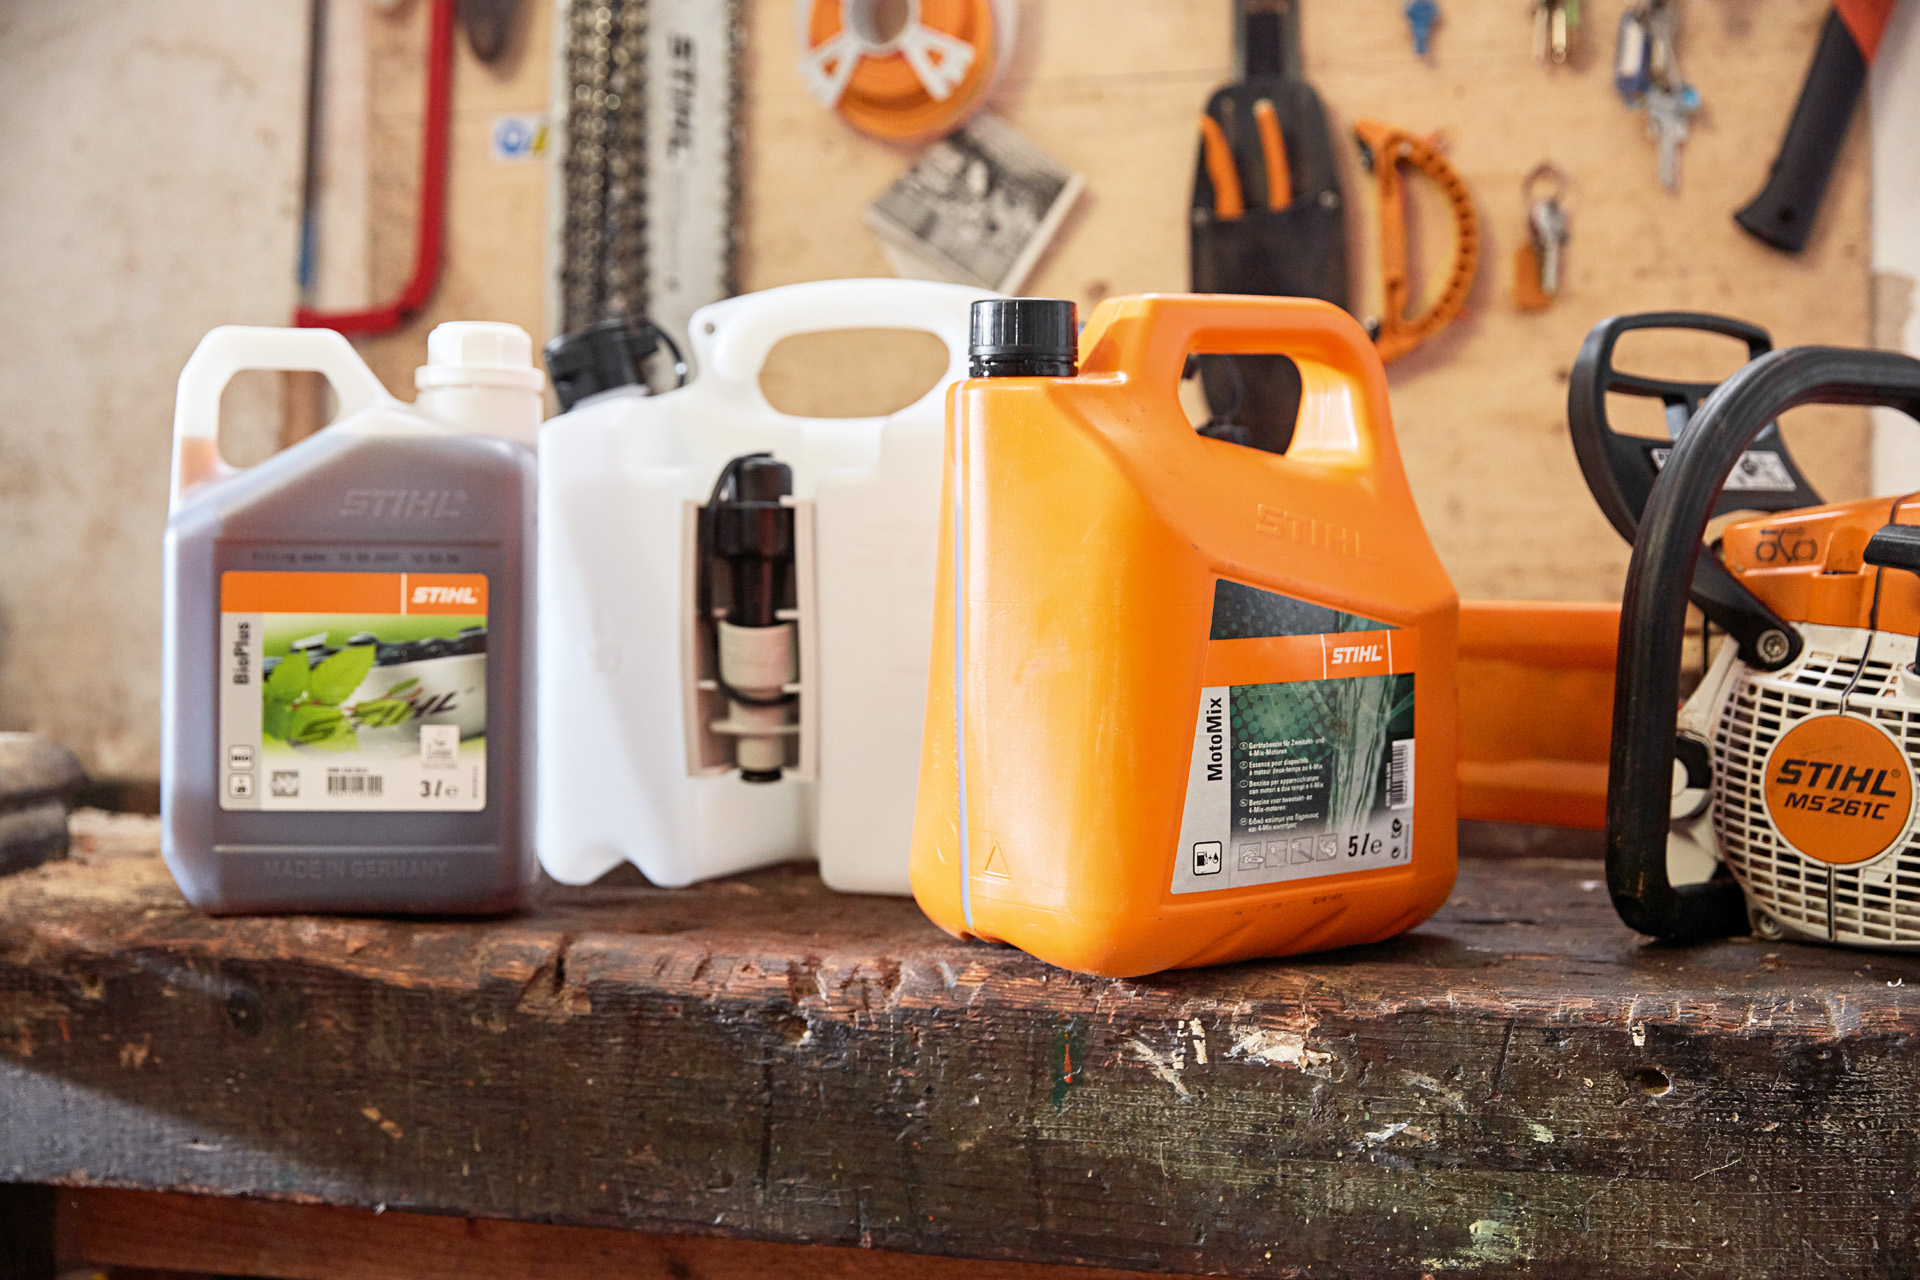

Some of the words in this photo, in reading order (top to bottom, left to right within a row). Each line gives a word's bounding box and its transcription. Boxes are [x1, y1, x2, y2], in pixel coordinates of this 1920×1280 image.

[667, 36, 697, 156] STIHL
[338, 488, 461, 518] STIHL
[1256, 503, 1382, 563] STIHL
[411, 586, 478, 604] STIHL
[233, 622, 251, 685] BioPlus
[1331, 645, 1382, 664] STIHL
[1206, 697, 1223, 781] MotoMix
[1249, 748, 1287, 757] 4-Mix-Motoren
[1249, 761, 1270, 769] Essence
[1271, 760, 1283, 769] pour
[1254, 768, 1272, 776] moteur
[1271, 779, 1280, 787] per
[1776, 759, 1896, 797] STIHL
[1249, 805, 1286, 813] 4-Mix-motoren
[263, 859, 322, 879] MADE
[325, 859, 345, 879] IN
[350, 859, 449, 879] GERMANY
